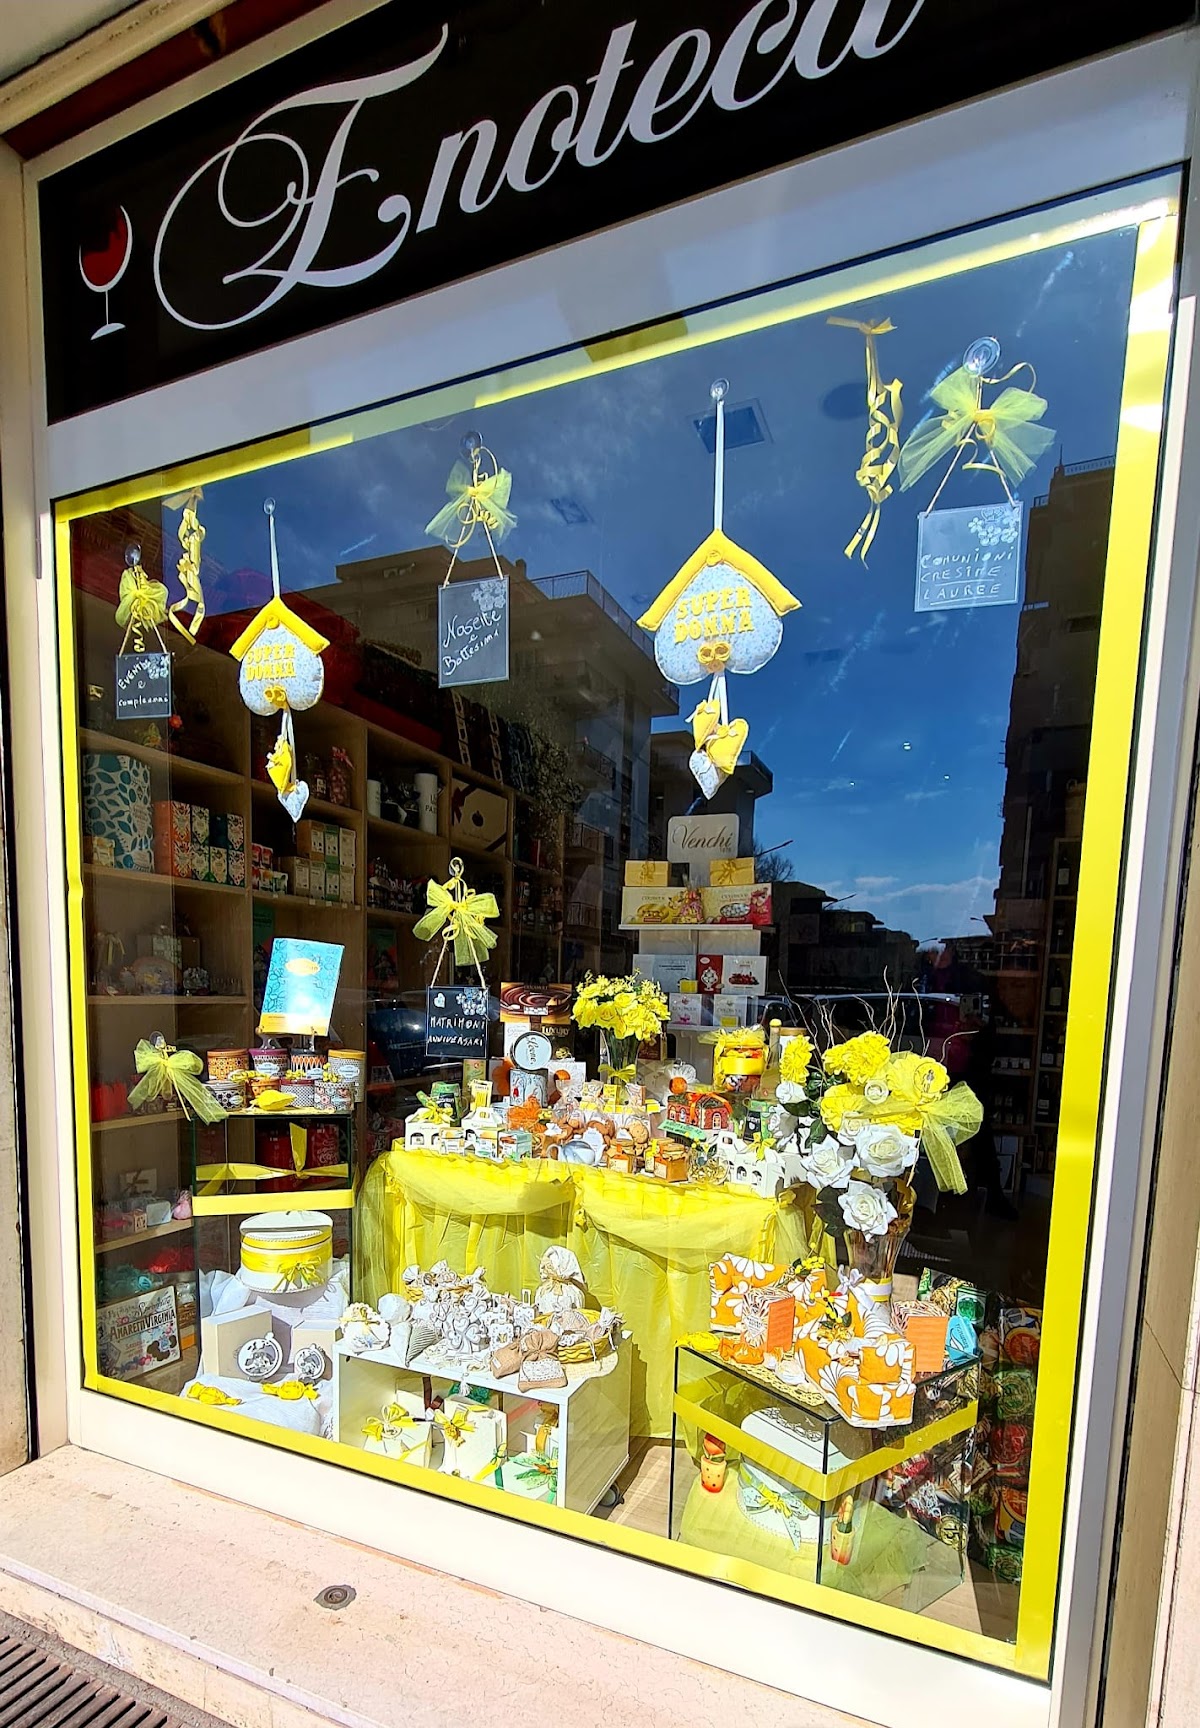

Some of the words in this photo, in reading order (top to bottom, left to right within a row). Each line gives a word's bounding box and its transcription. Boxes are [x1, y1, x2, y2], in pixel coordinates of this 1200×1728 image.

[152, 0, 925, 331] Enoteca
[676, 586, 752, 620] SUPER
[923, 583, 1002, 600] LAUREE
[674, 609, 755, 645] DONNA
[246, 642, 296, 665] SUPER
[246, 660, 297, 682] DONNA
[137, 680, 147, 690] e
[671, 823, 736, 850] Venchi
[144, 1309, 176, 1329] VIRGINIA
